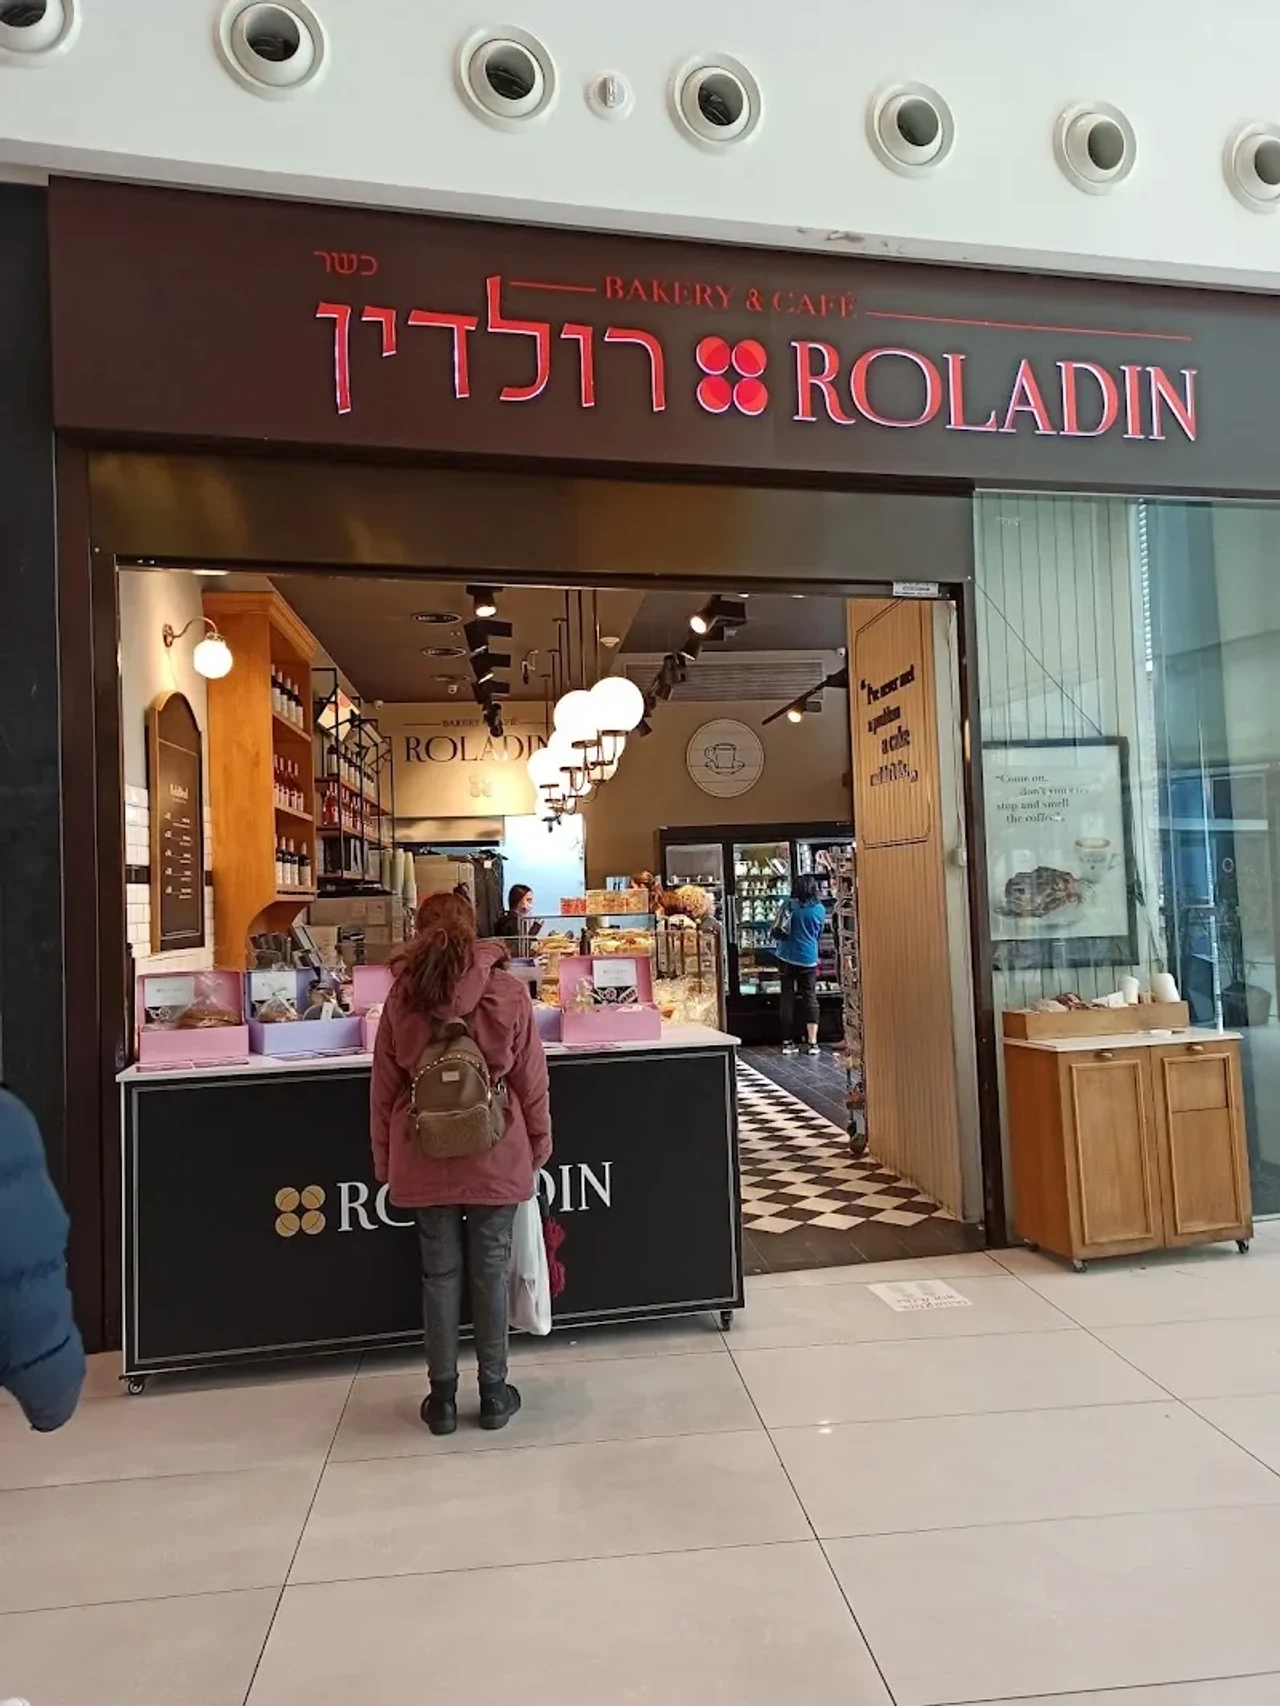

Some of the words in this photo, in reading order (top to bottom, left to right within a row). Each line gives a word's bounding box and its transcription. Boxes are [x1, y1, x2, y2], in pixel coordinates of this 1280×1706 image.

[313, 250, 378, 276] כשר
[604, 275, 735, 309] BAKERY
[745, 287, 764, 312] &
[771, 291, 859, 319] CAFÉ
[315, 275, 666, 415] רולדין
[790, 339, 1198, 442] ROLADIN
[442, 718, 480, 728] BAKERY
[996, 801, 1018, 813] stop
[1020, 799, 1040, 810] and
[1042, 798, 1070, 809] smell
[1006, 813, 1024, 825] the
[336, 1161, 614, 1232] RODIN
